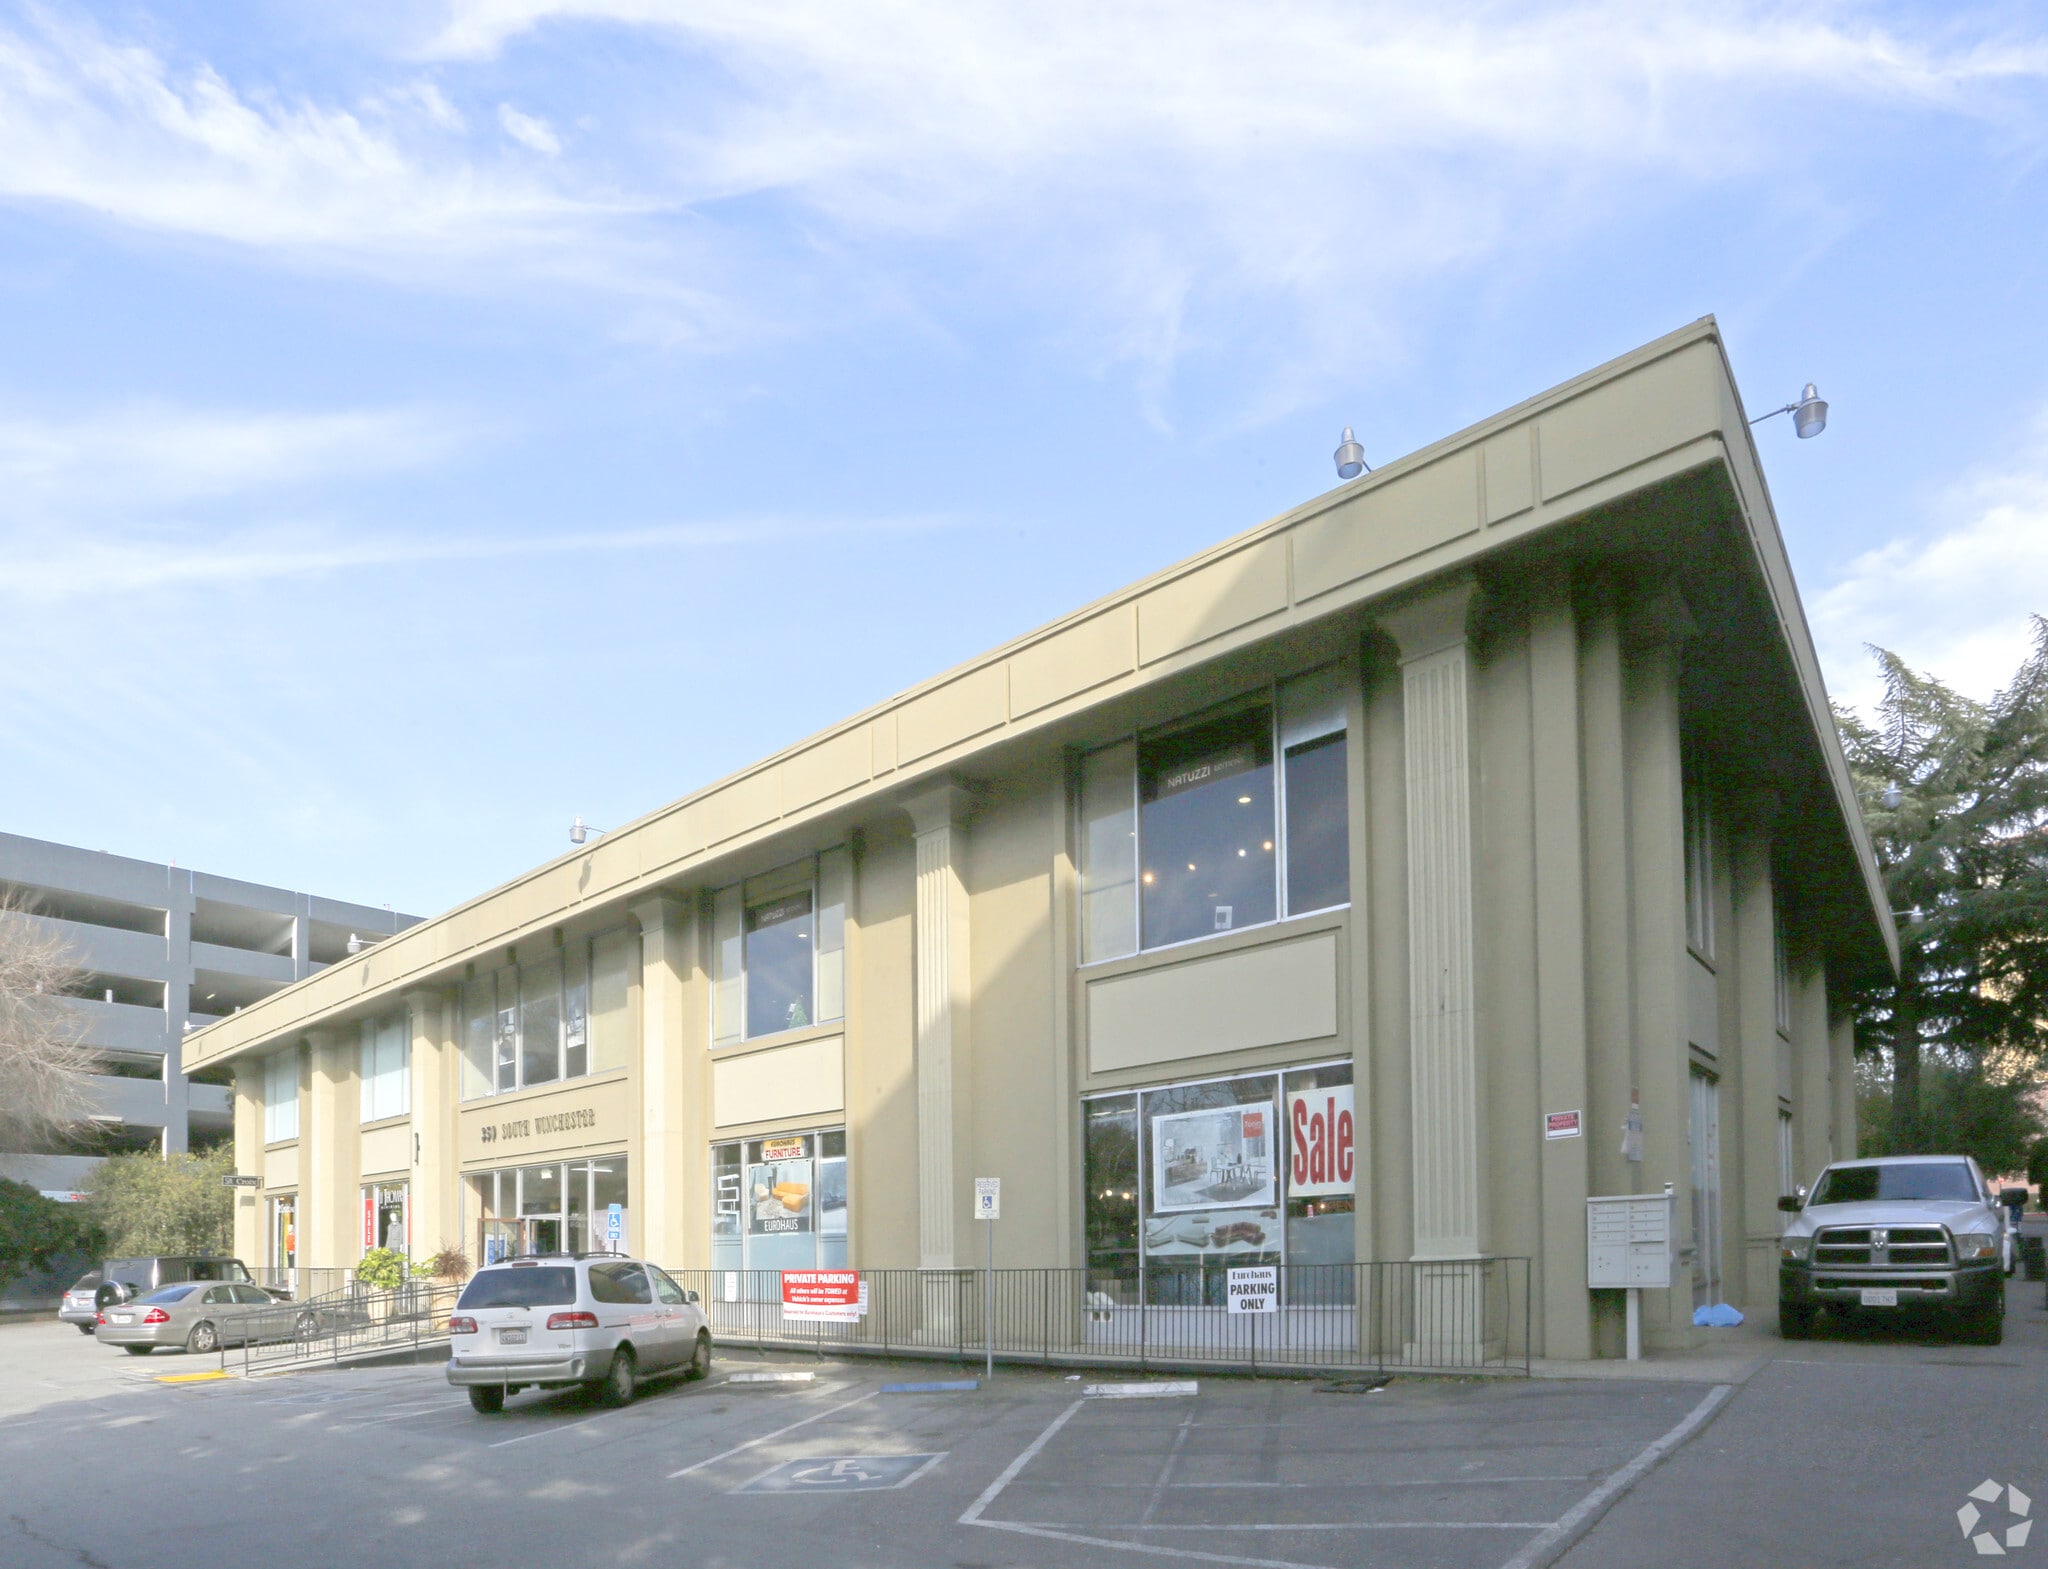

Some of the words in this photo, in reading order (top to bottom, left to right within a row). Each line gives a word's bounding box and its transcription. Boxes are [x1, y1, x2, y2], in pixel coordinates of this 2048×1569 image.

[1167, 765, 1211, 788] NATUZZI
[501, 1119, 530, 1140] SOUTH
[534, 1108, 596, 1135] WINCHESTER
[1293, 1096, 1354, 1186] Sale
[765, 1146, 801, 1159] FURNITURE
[764, 1219, 799, 1232] EUROHAUS
[784, 1273, 817, 1284] PRIVATE
[817, 1273, 855, 1284] PARKING
[1232, 1270, 1272, 1280] Eurohaus
[1230, 1282, 1275, 1296] PARKING
[1240, 1298, 1265, 1310] ONLY
